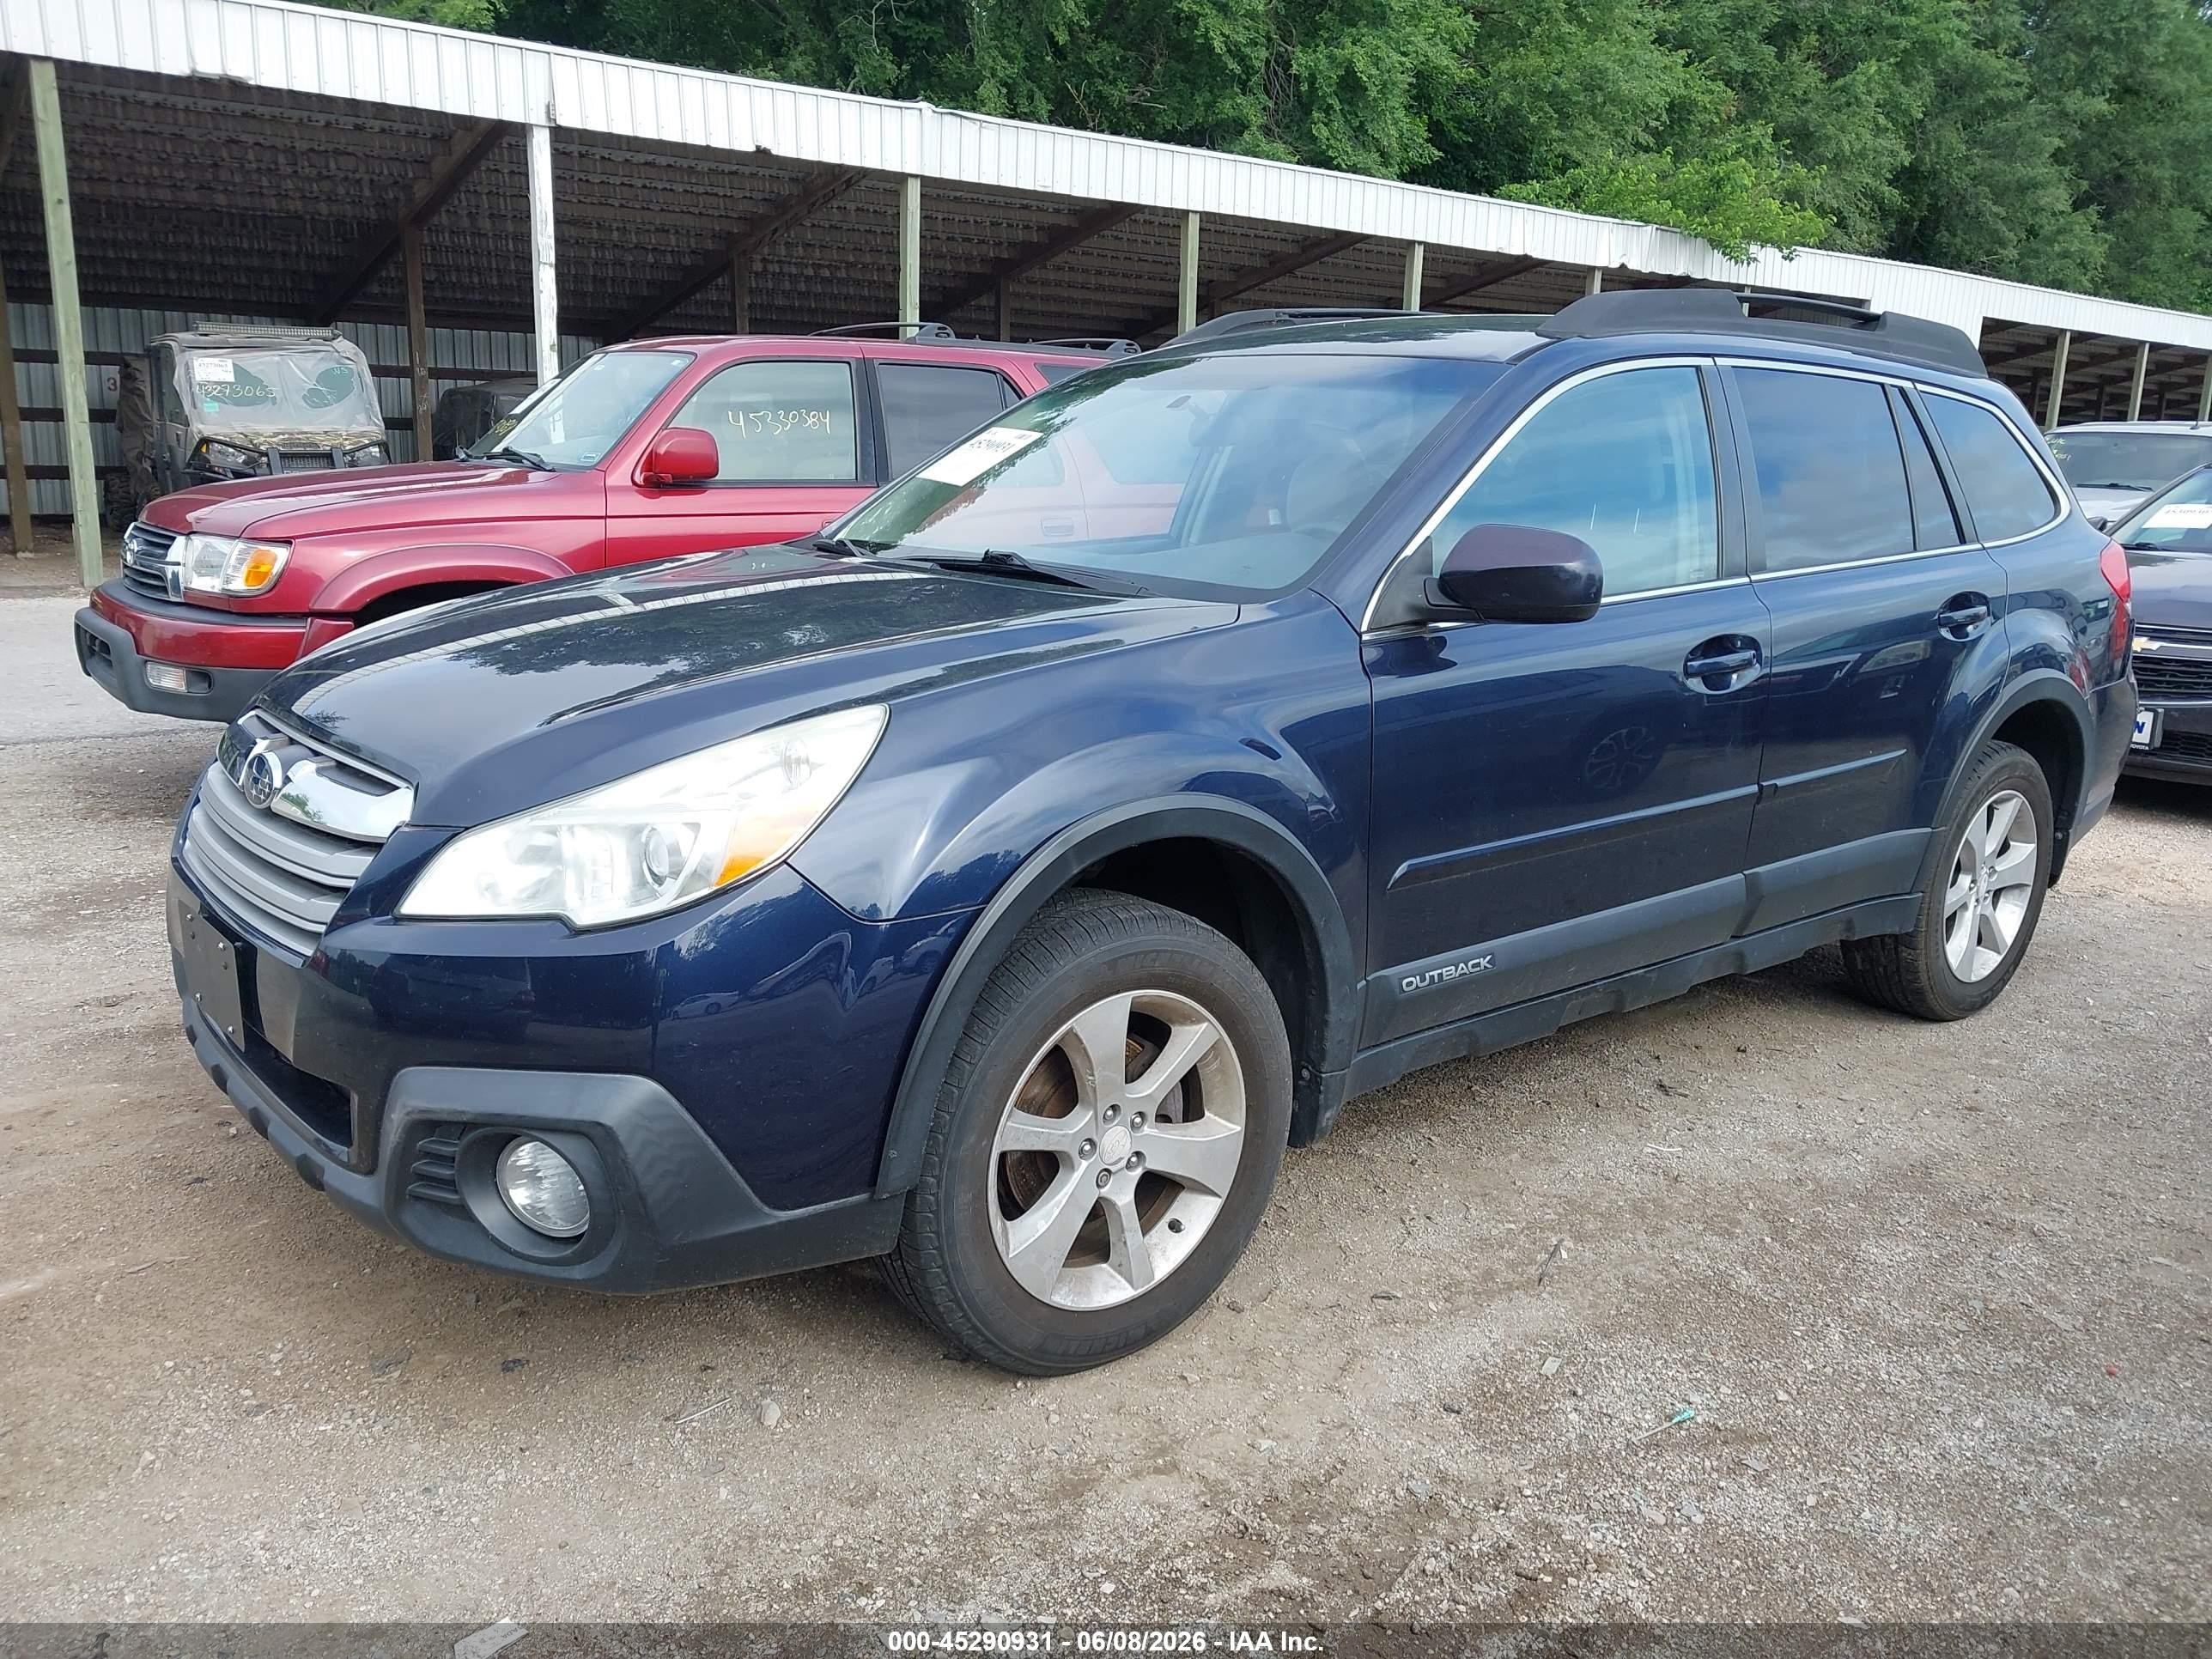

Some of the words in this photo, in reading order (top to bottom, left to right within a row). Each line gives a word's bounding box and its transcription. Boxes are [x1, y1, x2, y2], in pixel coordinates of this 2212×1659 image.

[196, 384, 278, 398] 43273065
[727, 409, 831, 439] 45330384
[1401, 954, 1494, 993] OUTBACK
